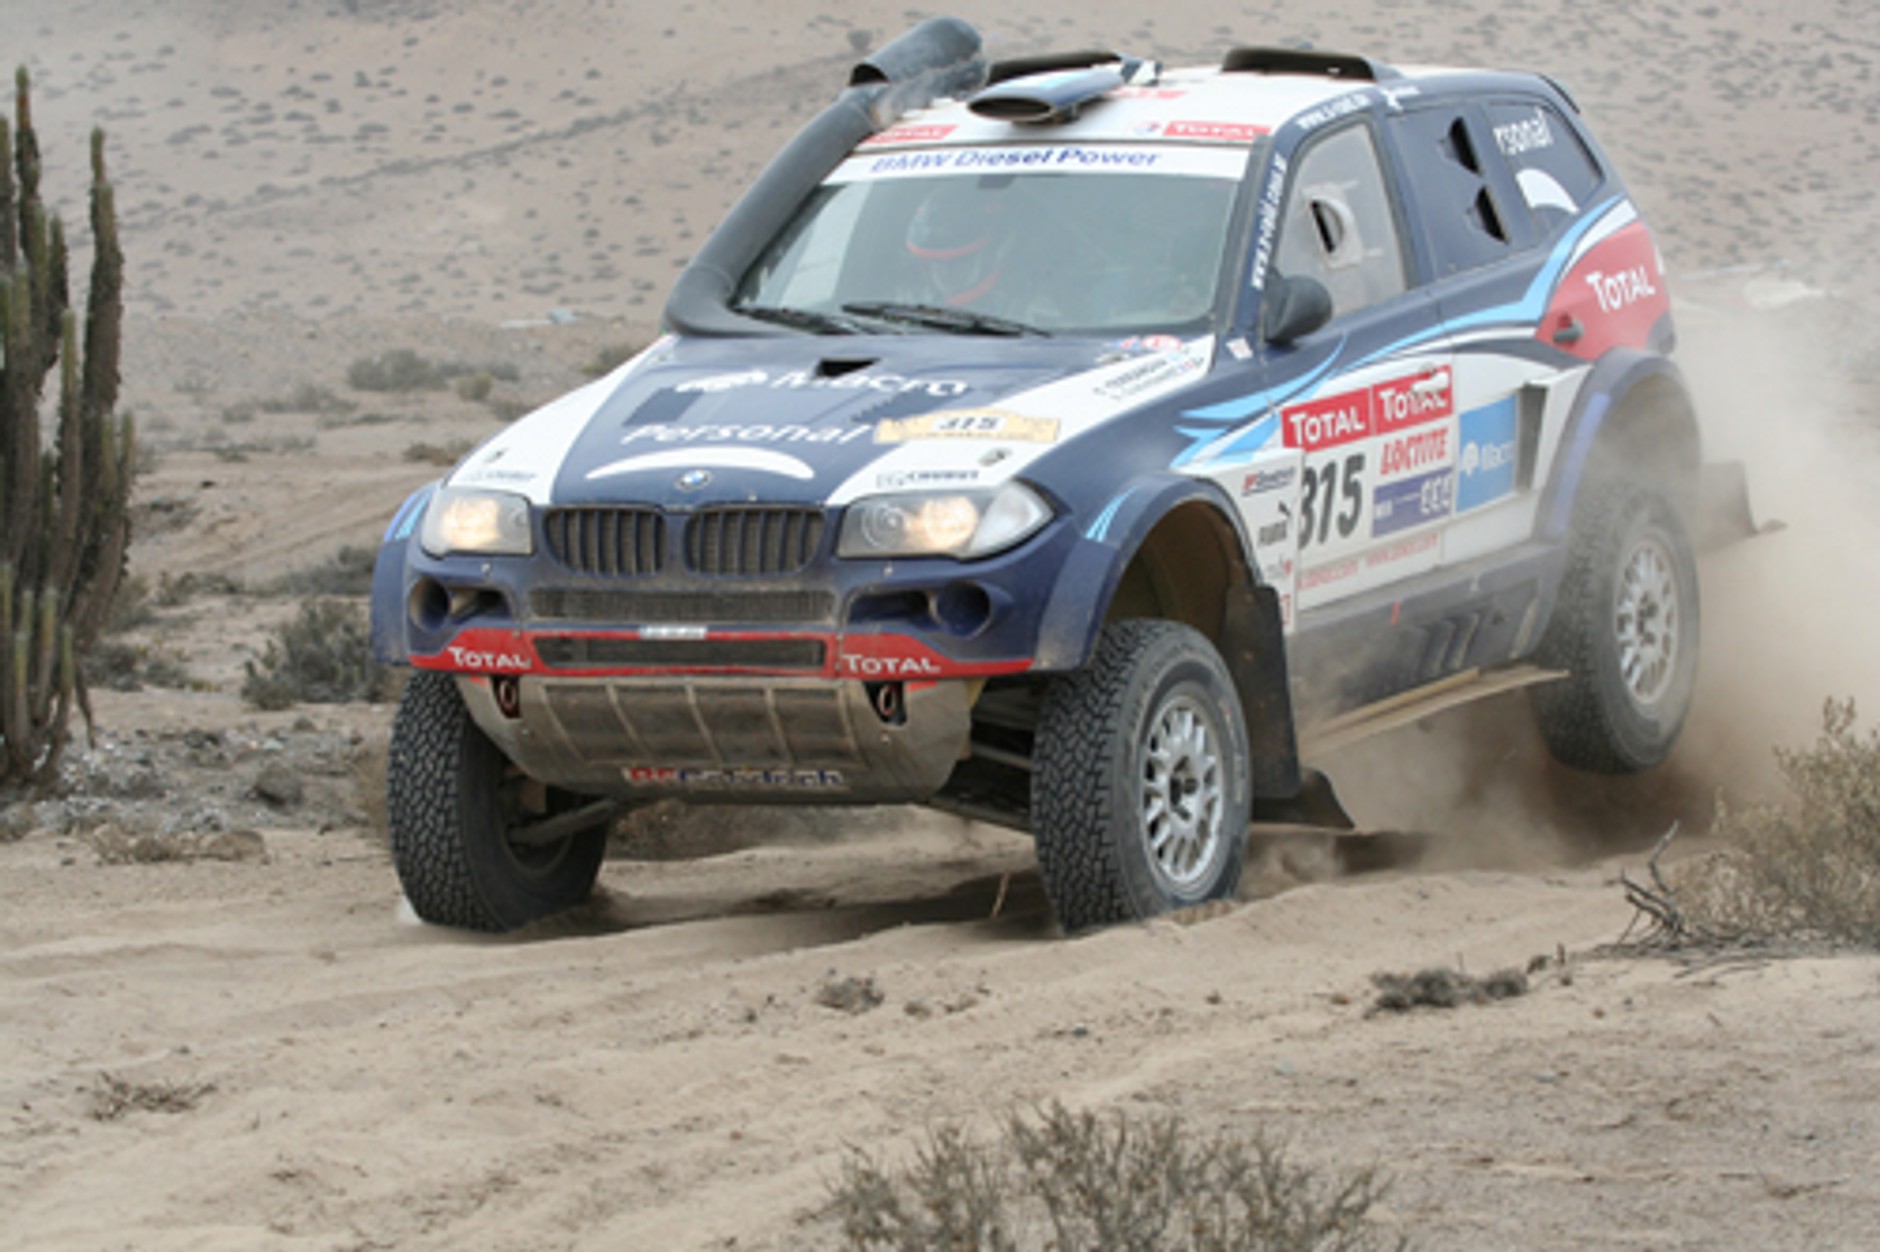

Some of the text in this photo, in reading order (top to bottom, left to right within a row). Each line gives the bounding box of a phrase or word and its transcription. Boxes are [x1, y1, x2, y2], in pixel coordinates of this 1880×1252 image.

[1174, 123, 1256, 138] TOTAL
[871, 147, 1160, 173] BMW Diesel Power
[1585, 263, 1656, 314] TOTAL
[619, 423, 874, 445] Personal
[939, 416, 1000, 431] 315
[1290, 406, 1365, 446] TOTAL
[1297, 452, 1366, 550] 315
[446, 645, 530, 670] TOTAL
[842, 652, 942, 675] TOTAL
